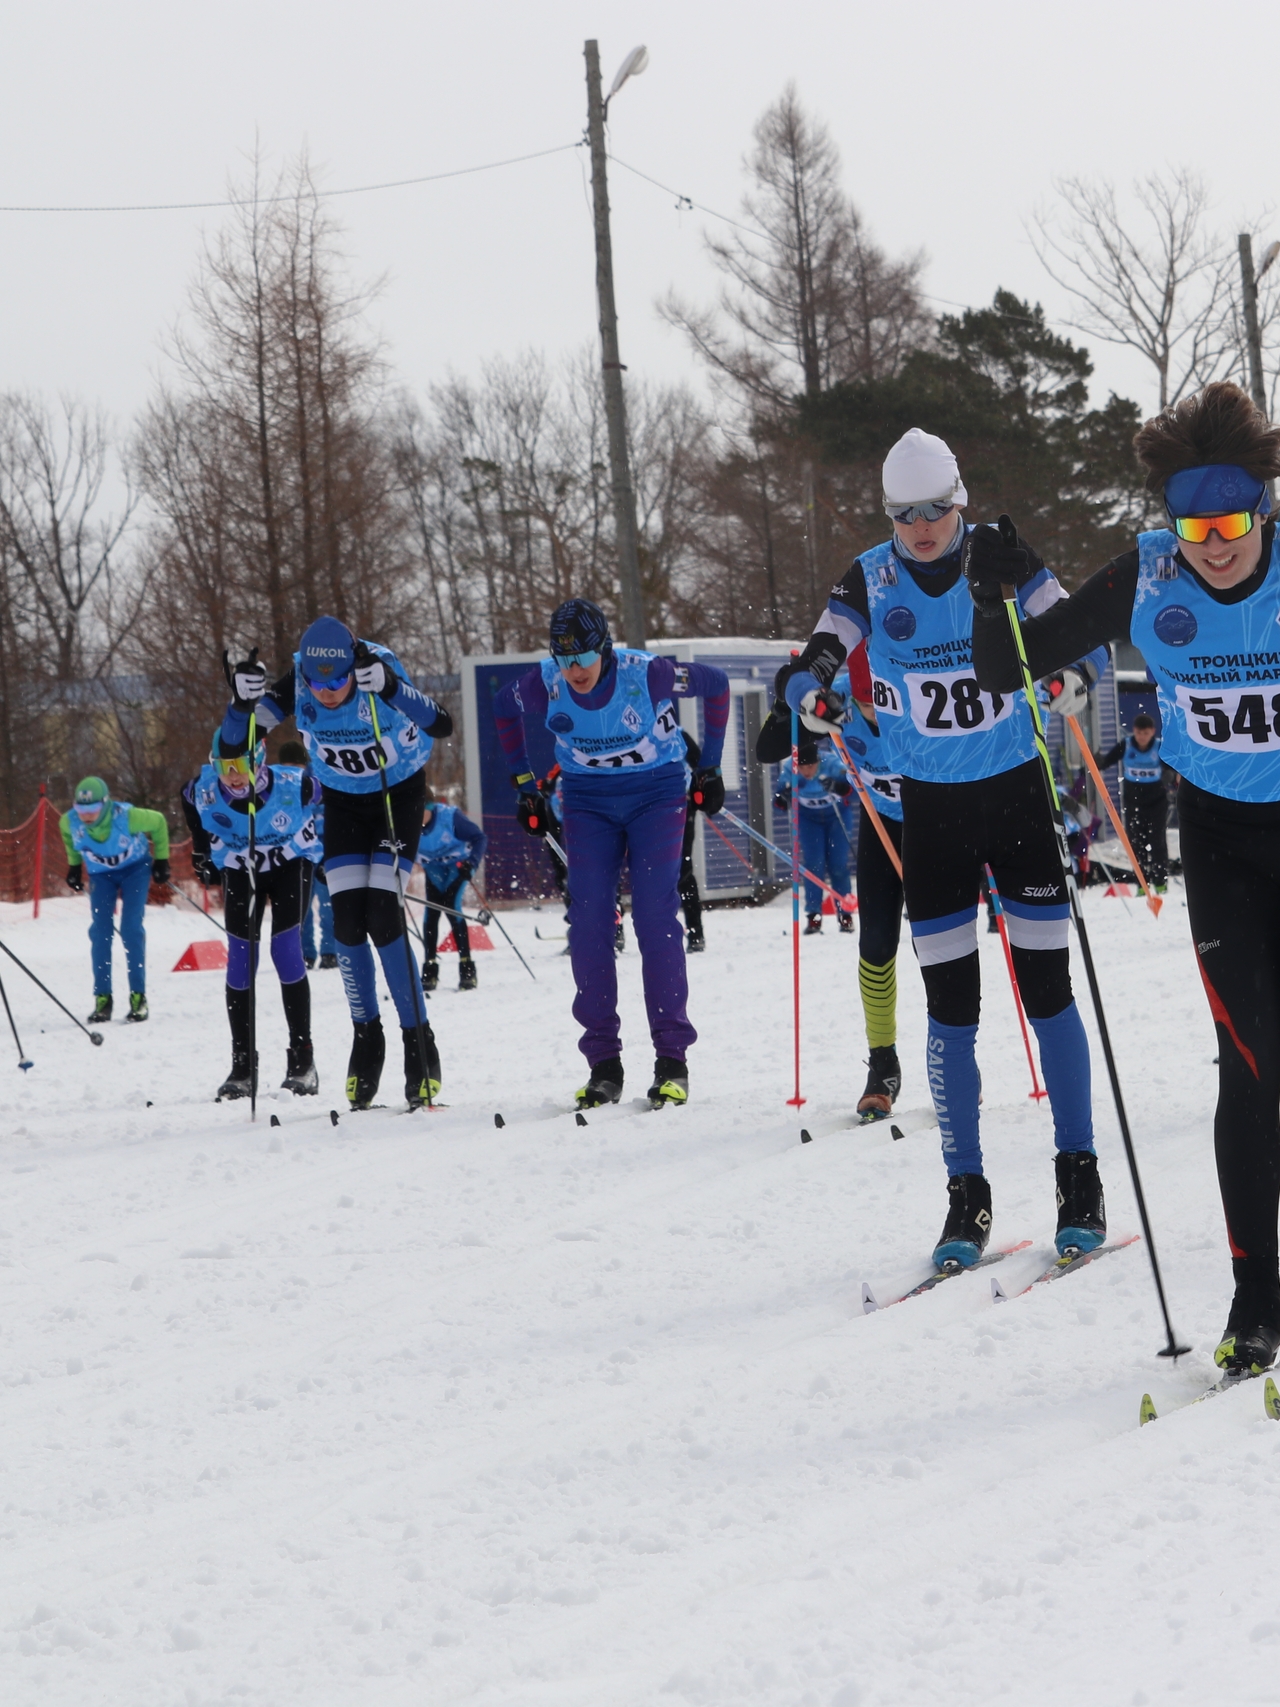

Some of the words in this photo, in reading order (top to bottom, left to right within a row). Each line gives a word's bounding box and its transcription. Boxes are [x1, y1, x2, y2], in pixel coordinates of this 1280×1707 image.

[306, 646, 347, 658] LUKOIL
[913, 637, 973, 658] ТРОИЦК
[1159, 664, 1240, 685] ЛЫЖНЫЙ
[874, 681, 898, 710] 81
[571, 735, 632, 746] ТРОИЦКИЙ
[324, 746, 388, 774] 280
[336, 952, 366, 1019] SAKHALIN
[928, 1036, 957, 1153] SAKHALIN
